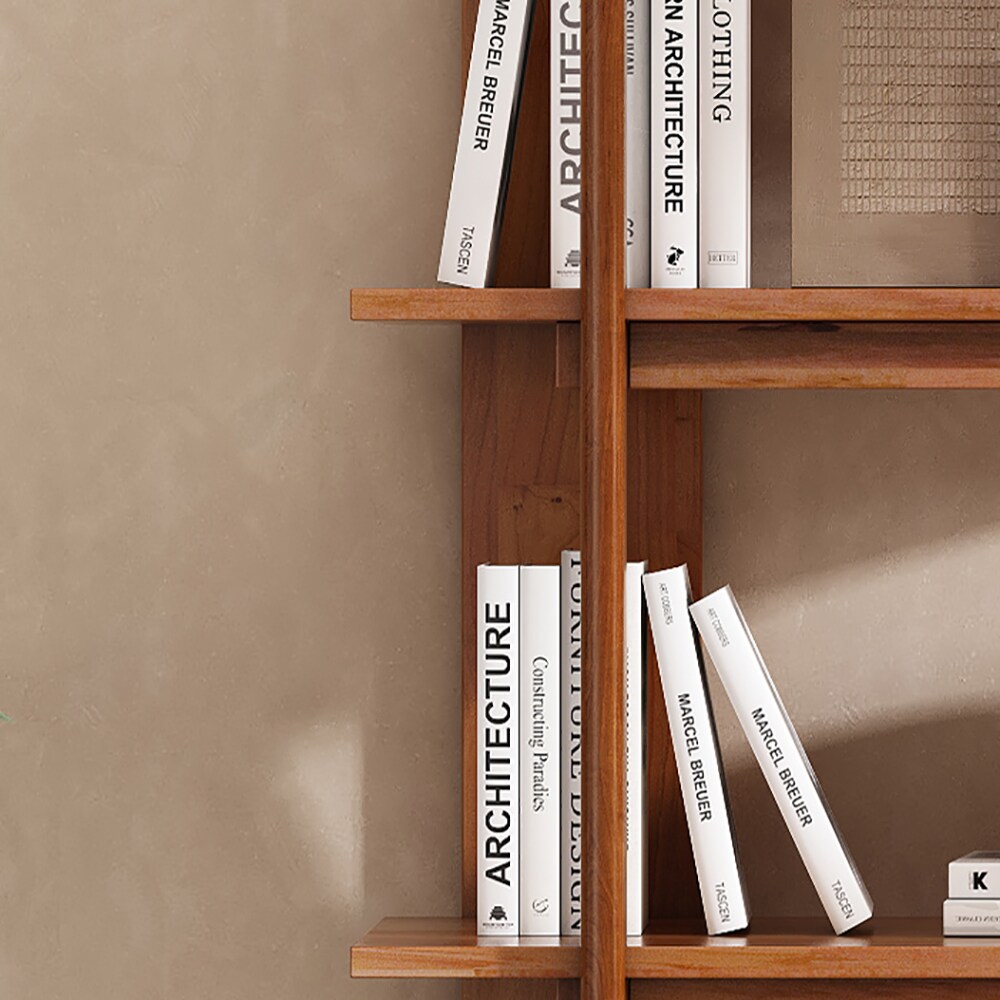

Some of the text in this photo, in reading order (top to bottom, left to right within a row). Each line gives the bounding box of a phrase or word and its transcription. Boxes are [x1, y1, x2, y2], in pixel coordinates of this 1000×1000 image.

[473, 75, 498, 152] BREUER
[664, 28, 684, 213] ARCHITECTURE
[456, 226, 475, 275] TASCEN
[485, 602, 511, 887] ARCHITECTURE
[529, 656, 549, 812] Constructing Paradies
[678, 693, 712, 822] MARCEL BREUER
[751, 707, 813, 828] MARCEL BREUER
[715, 882, 731, 923] TASCEN
[832, 880, 855, 920] TASCEN
